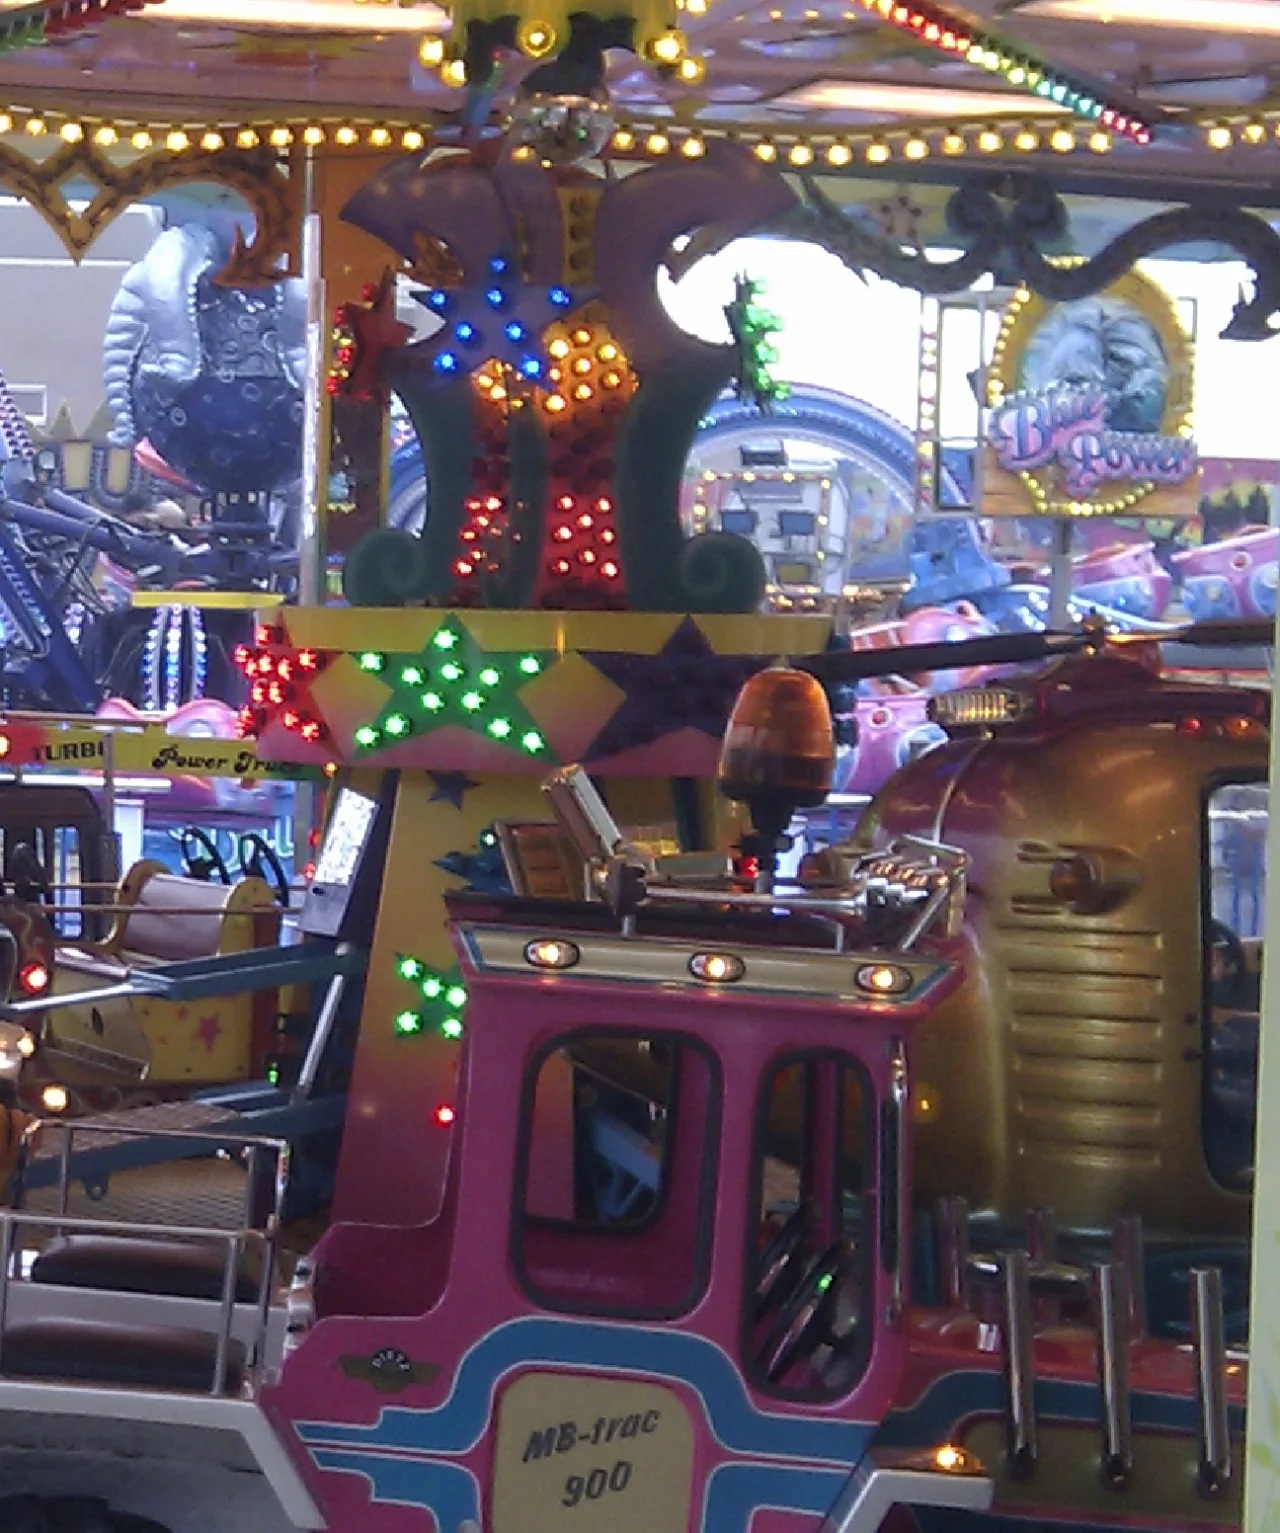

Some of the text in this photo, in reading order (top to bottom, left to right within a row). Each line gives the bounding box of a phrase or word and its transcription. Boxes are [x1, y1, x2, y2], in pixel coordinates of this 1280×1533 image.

[1065, 433, 1196, 498] Power
[152, 746, 231, 770] Power
[522, 1409, 660, 1463] MB-trac
[562, 1460, 633, 1507] 900
